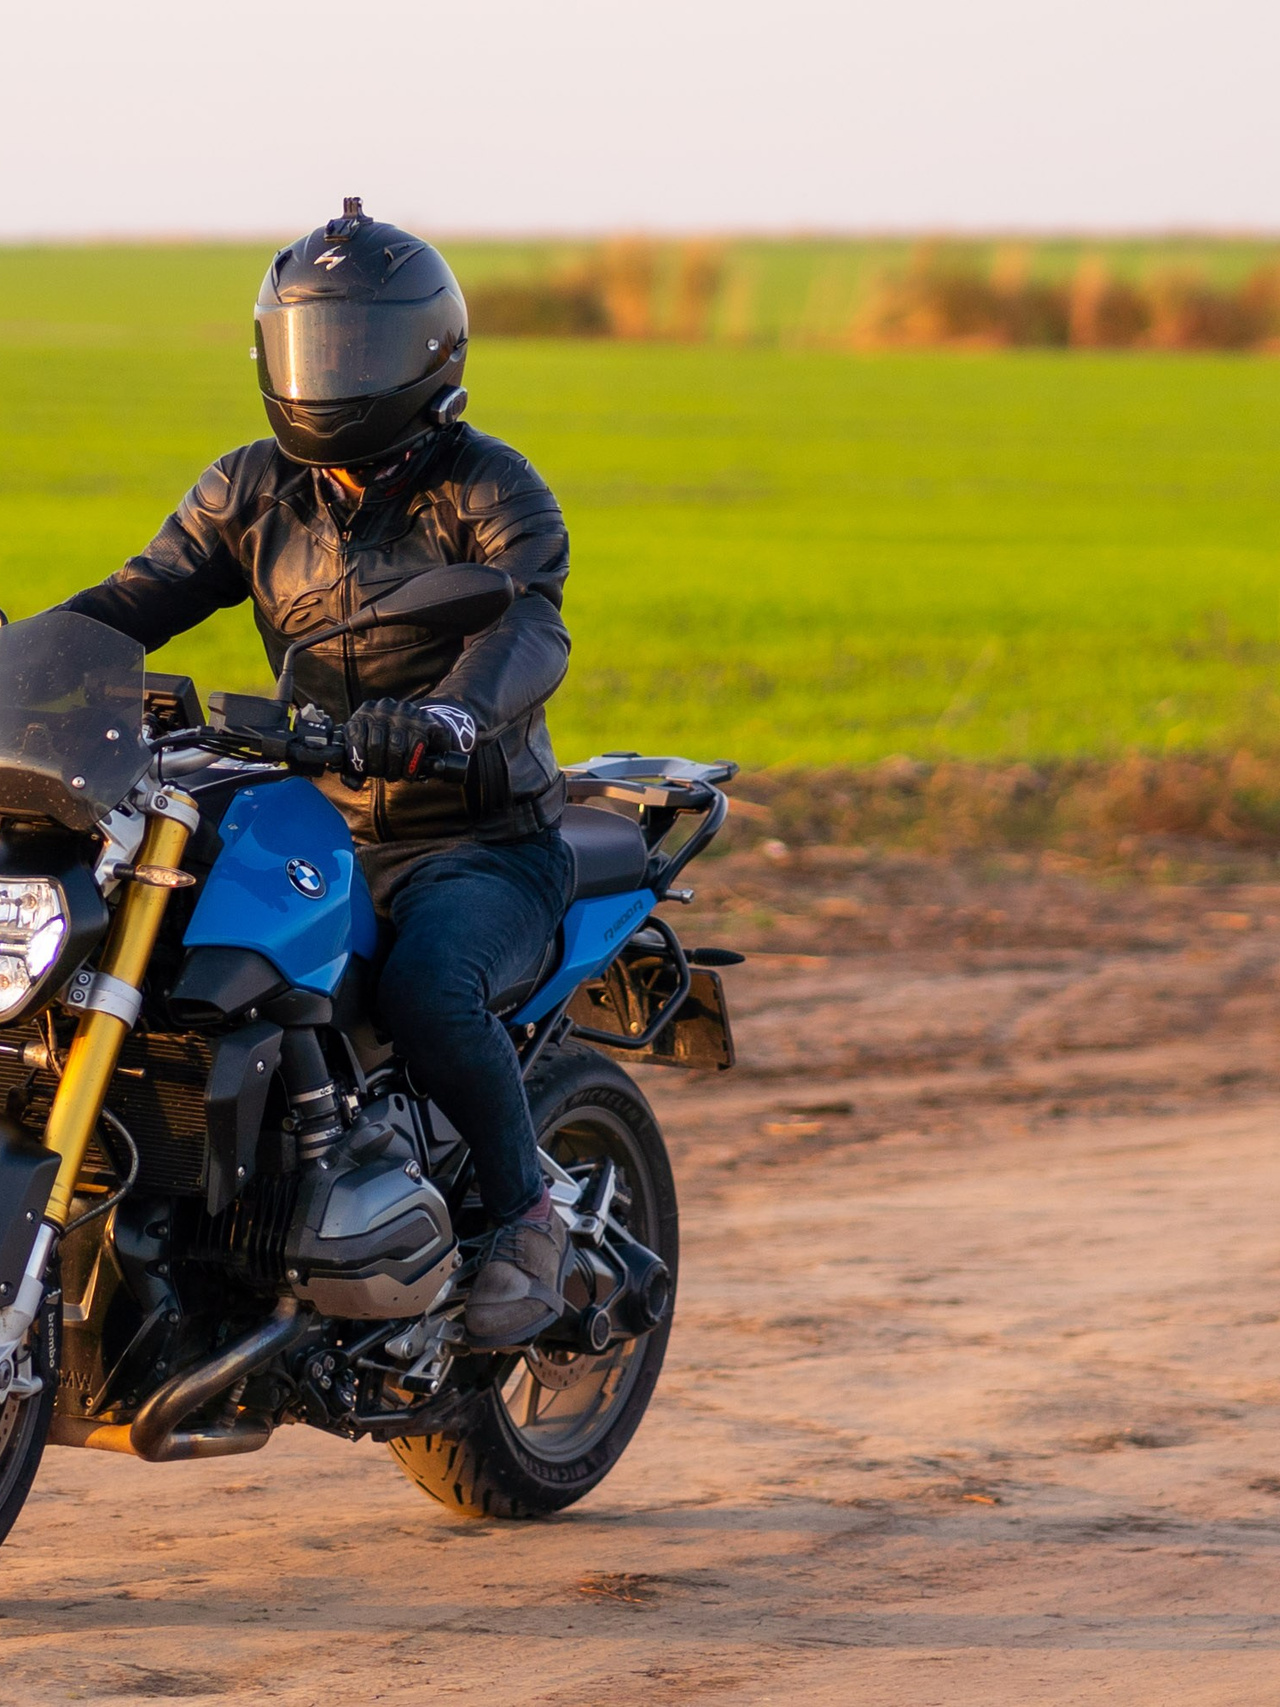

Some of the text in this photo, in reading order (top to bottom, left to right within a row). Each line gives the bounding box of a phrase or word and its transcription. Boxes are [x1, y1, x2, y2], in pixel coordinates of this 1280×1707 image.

[569, 1088, 641, 1121] MICHELIN
[48, 1312, 56, 1368] brembo
[56, 1369, 93, 1391] MW
